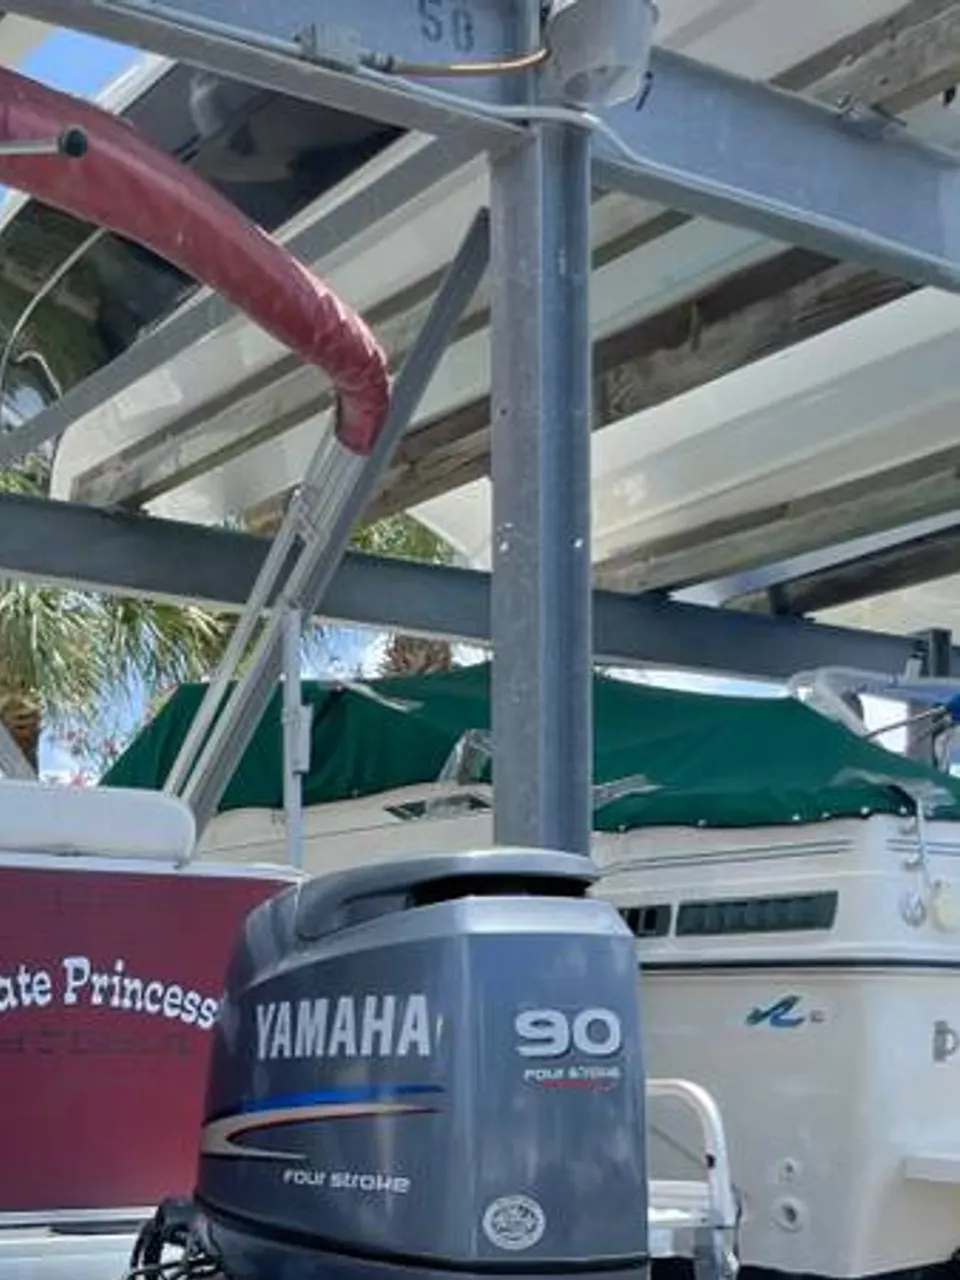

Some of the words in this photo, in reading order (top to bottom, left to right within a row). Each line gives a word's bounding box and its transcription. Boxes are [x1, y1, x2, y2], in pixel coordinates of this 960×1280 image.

[62, 956, 220, 1030] Princess
[256, 993, 431, 1061] YAMAHA
[514, 1007, 622, 1058] 90
